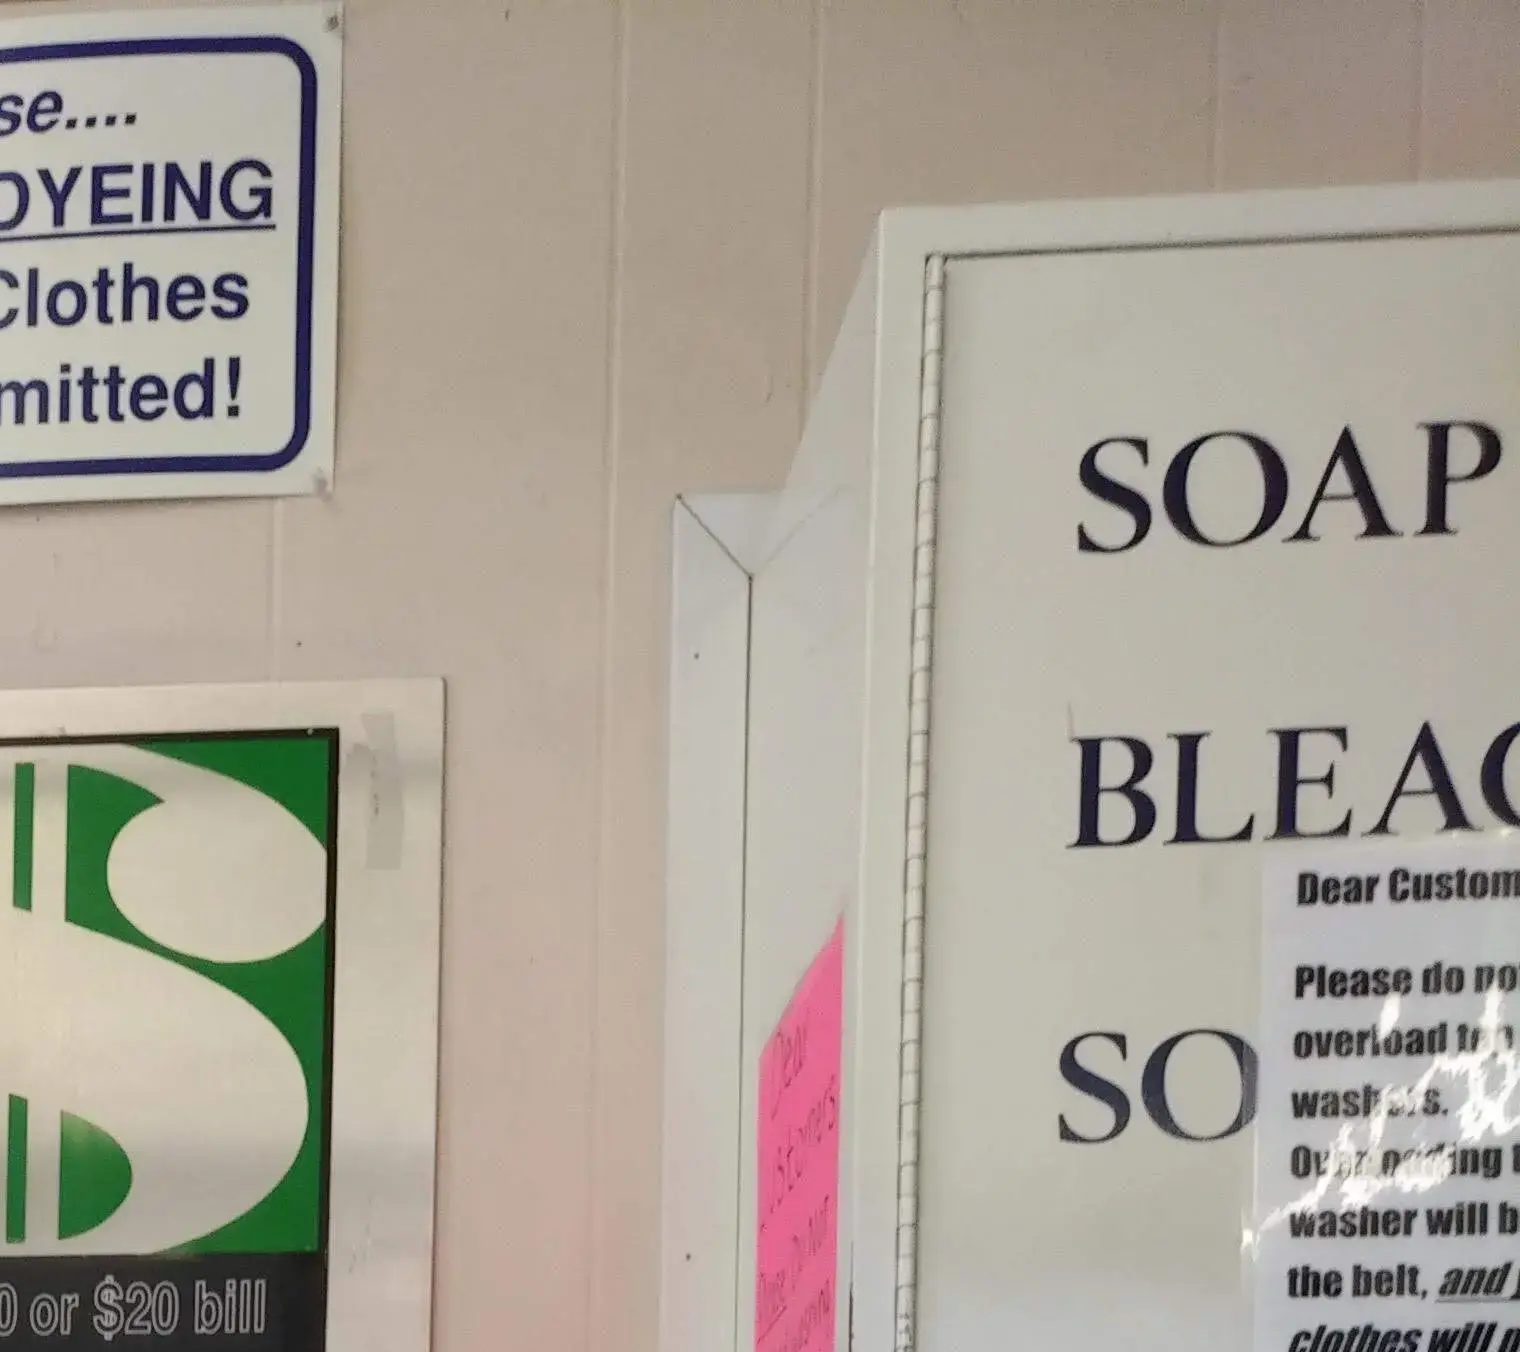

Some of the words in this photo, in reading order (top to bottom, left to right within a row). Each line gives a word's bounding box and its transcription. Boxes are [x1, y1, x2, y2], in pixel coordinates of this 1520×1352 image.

[1077, 420, 1504, 554] SOAP
[1297, 869, 1380, 907] Dear
[1295, 963, 1413, 999] Please
[1422, 960, 1465, 995] do
[1474, 964, 1520, 994] no
[1289, 1205, 1418, 1238] washer
[1426, 1201, 1489, 1236] will
[1288, 1264, 1343, 1299] the
[1352, 1263, 1428, 1301] belt,
[1439, 1261, 1513, 1298] and
[30, 1292, 79, 1337] or
[93, 1274, 180, 1341] $20
[194, 1279, 266, 1335] bill
